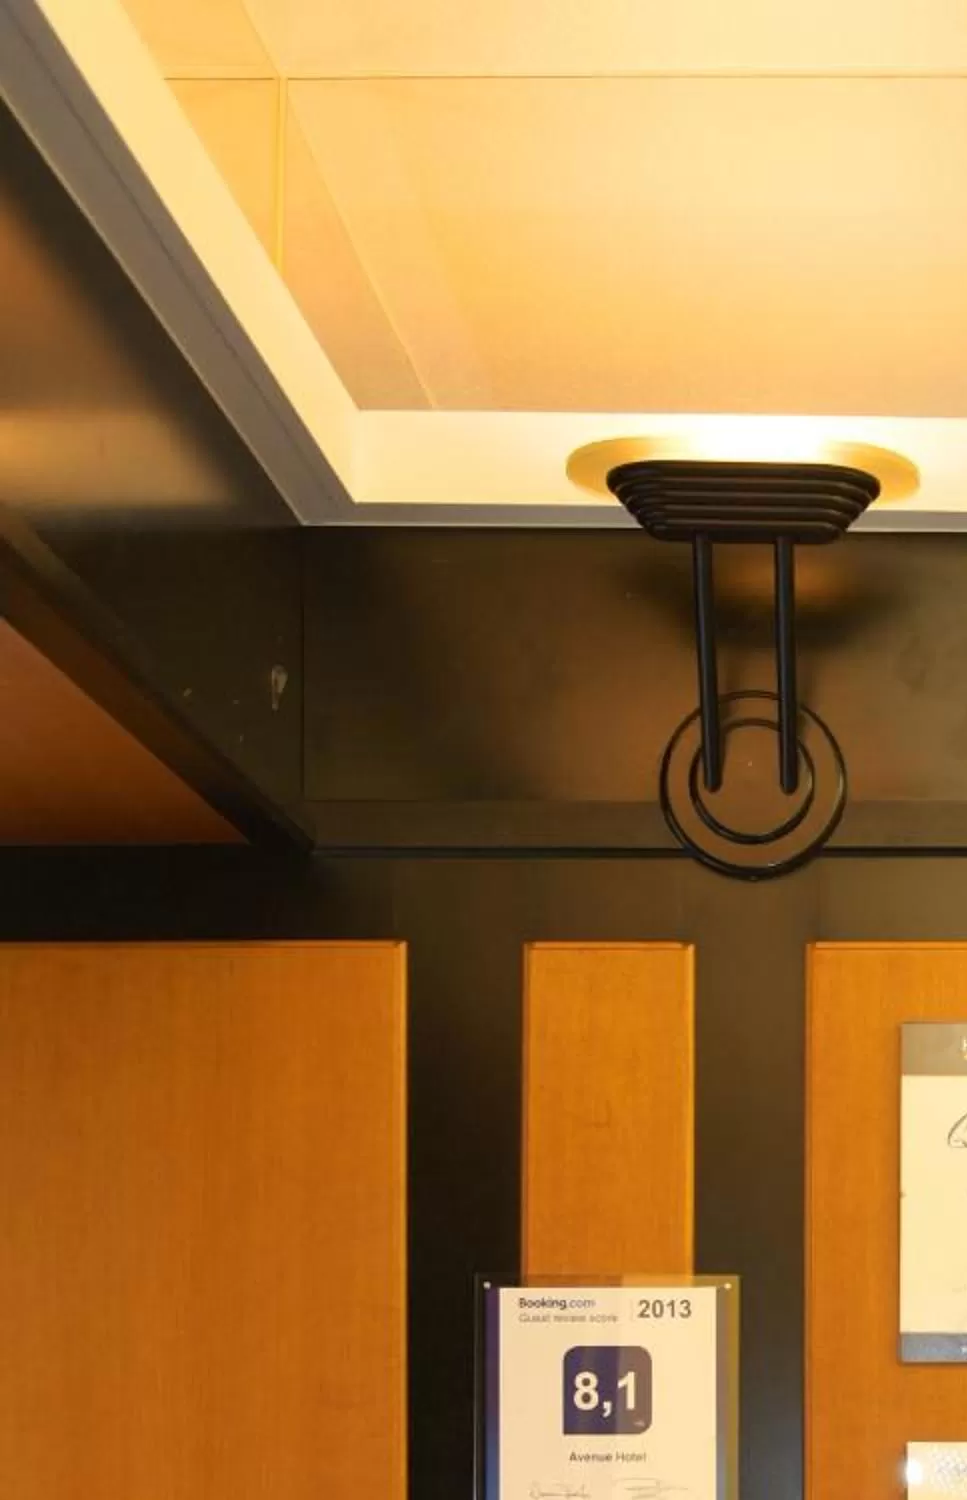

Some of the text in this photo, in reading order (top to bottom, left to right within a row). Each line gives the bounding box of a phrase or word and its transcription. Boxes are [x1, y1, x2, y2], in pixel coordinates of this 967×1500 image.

[518, 1297, 596, 1310] Booking.com
[637, 1300, 692, 1319] 2013
[573, 1371, 636, 1418] 8,1
[569, 1451, 647, 1463] Avenue Hotel
